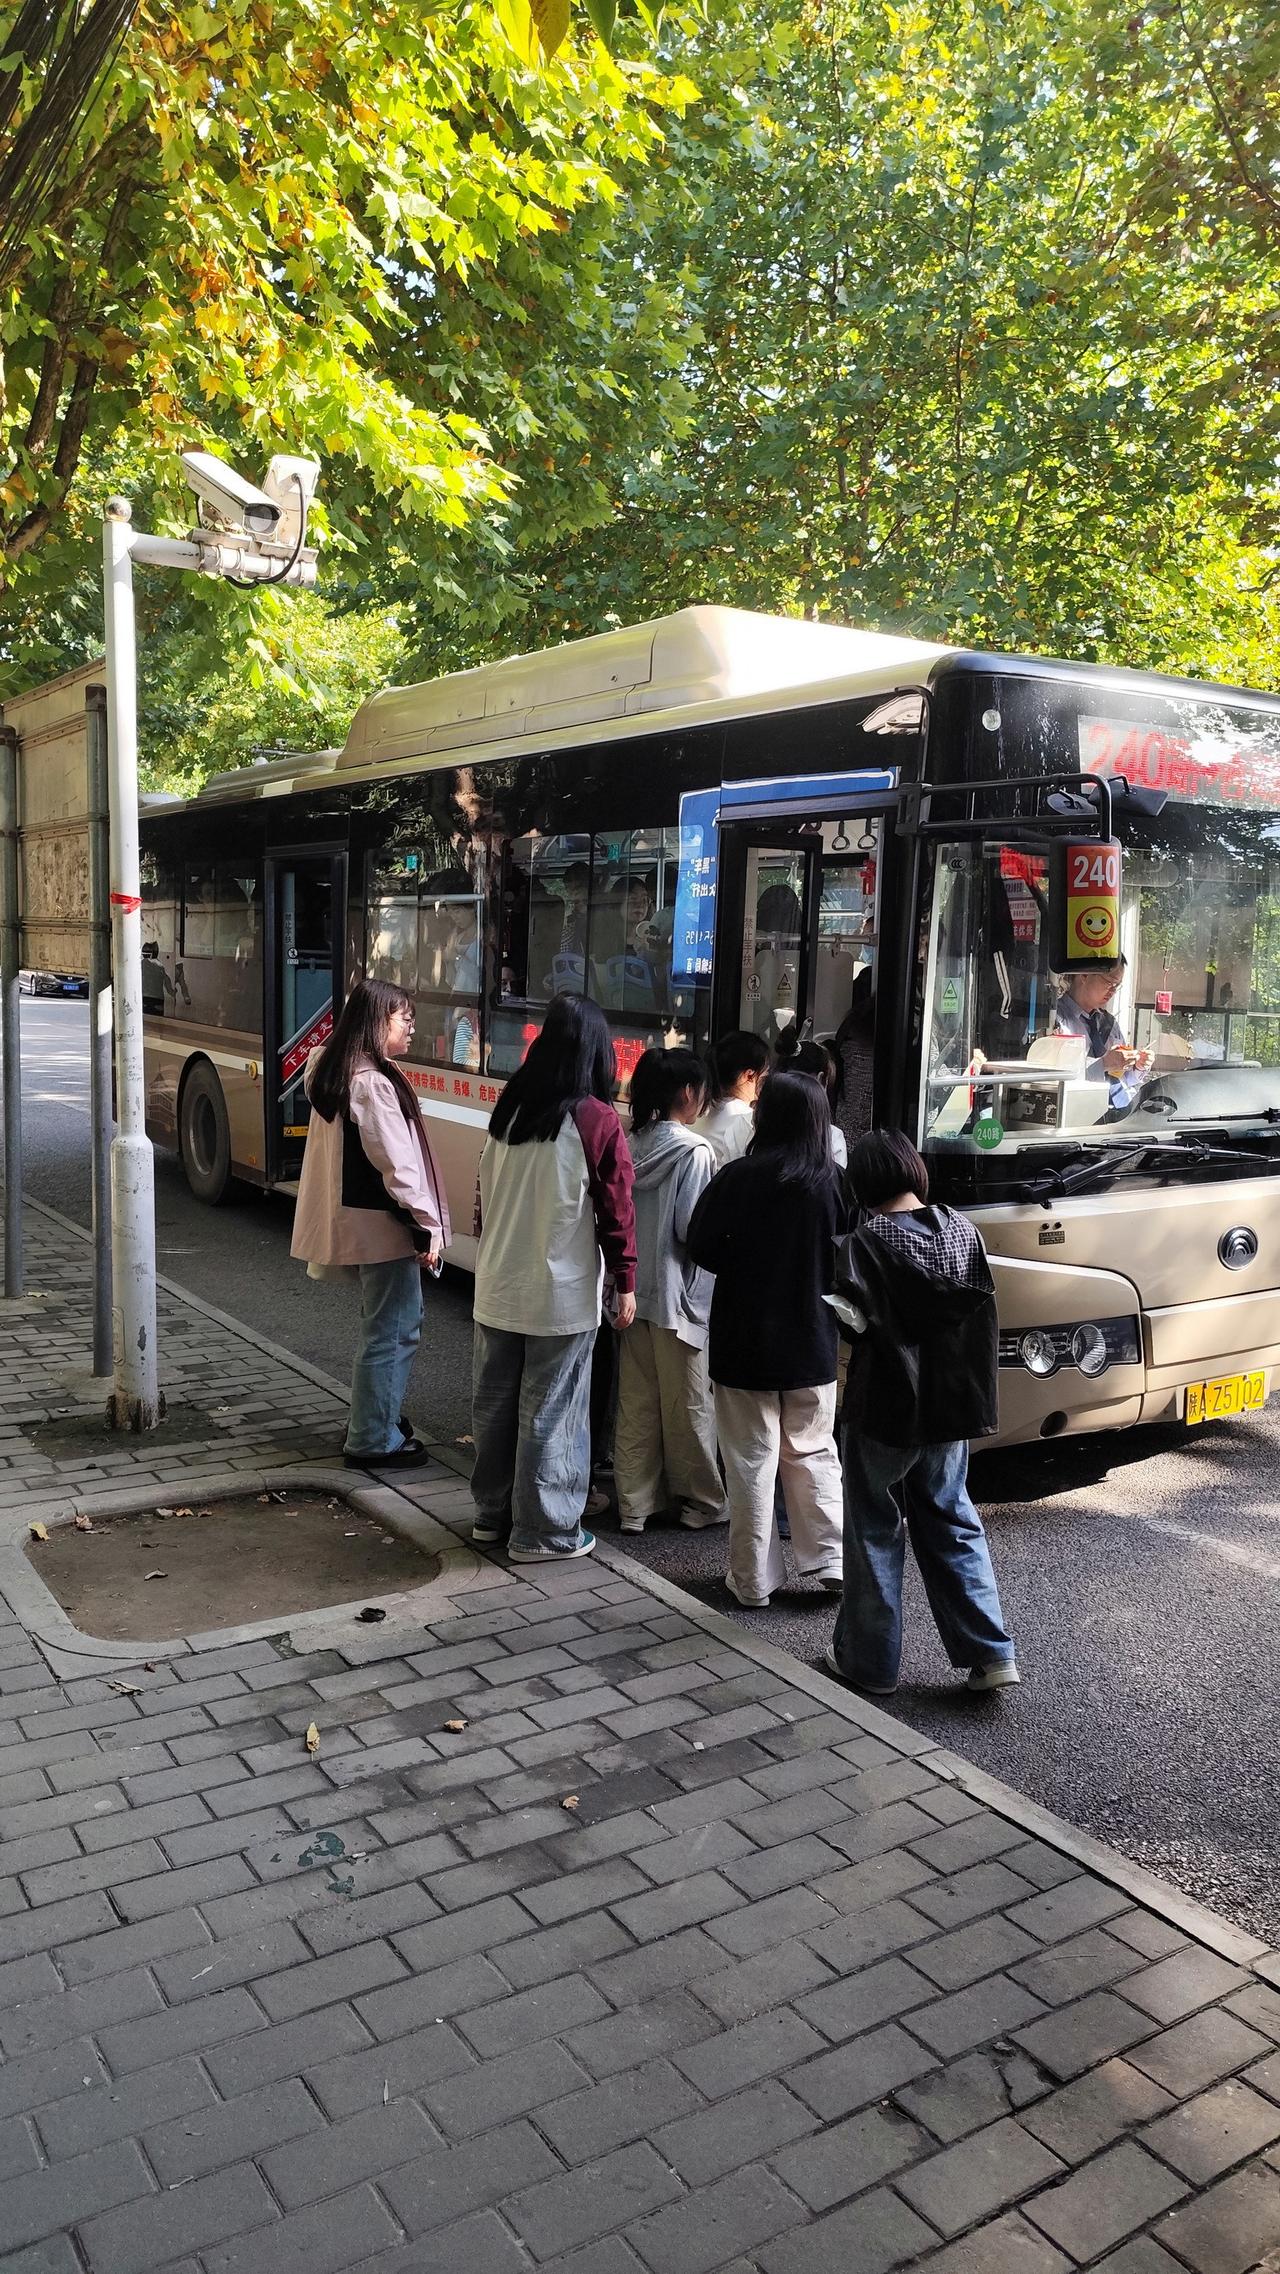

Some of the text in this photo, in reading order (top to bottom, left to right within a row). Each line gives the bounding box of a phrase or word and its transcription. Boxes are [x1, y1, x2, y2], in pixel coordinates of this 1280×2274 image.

[1073, 855, 1118, 888] 240
[285, 1014, 333, 1066] 下车请走
[977, 1127, 1000, 1141] 240路
